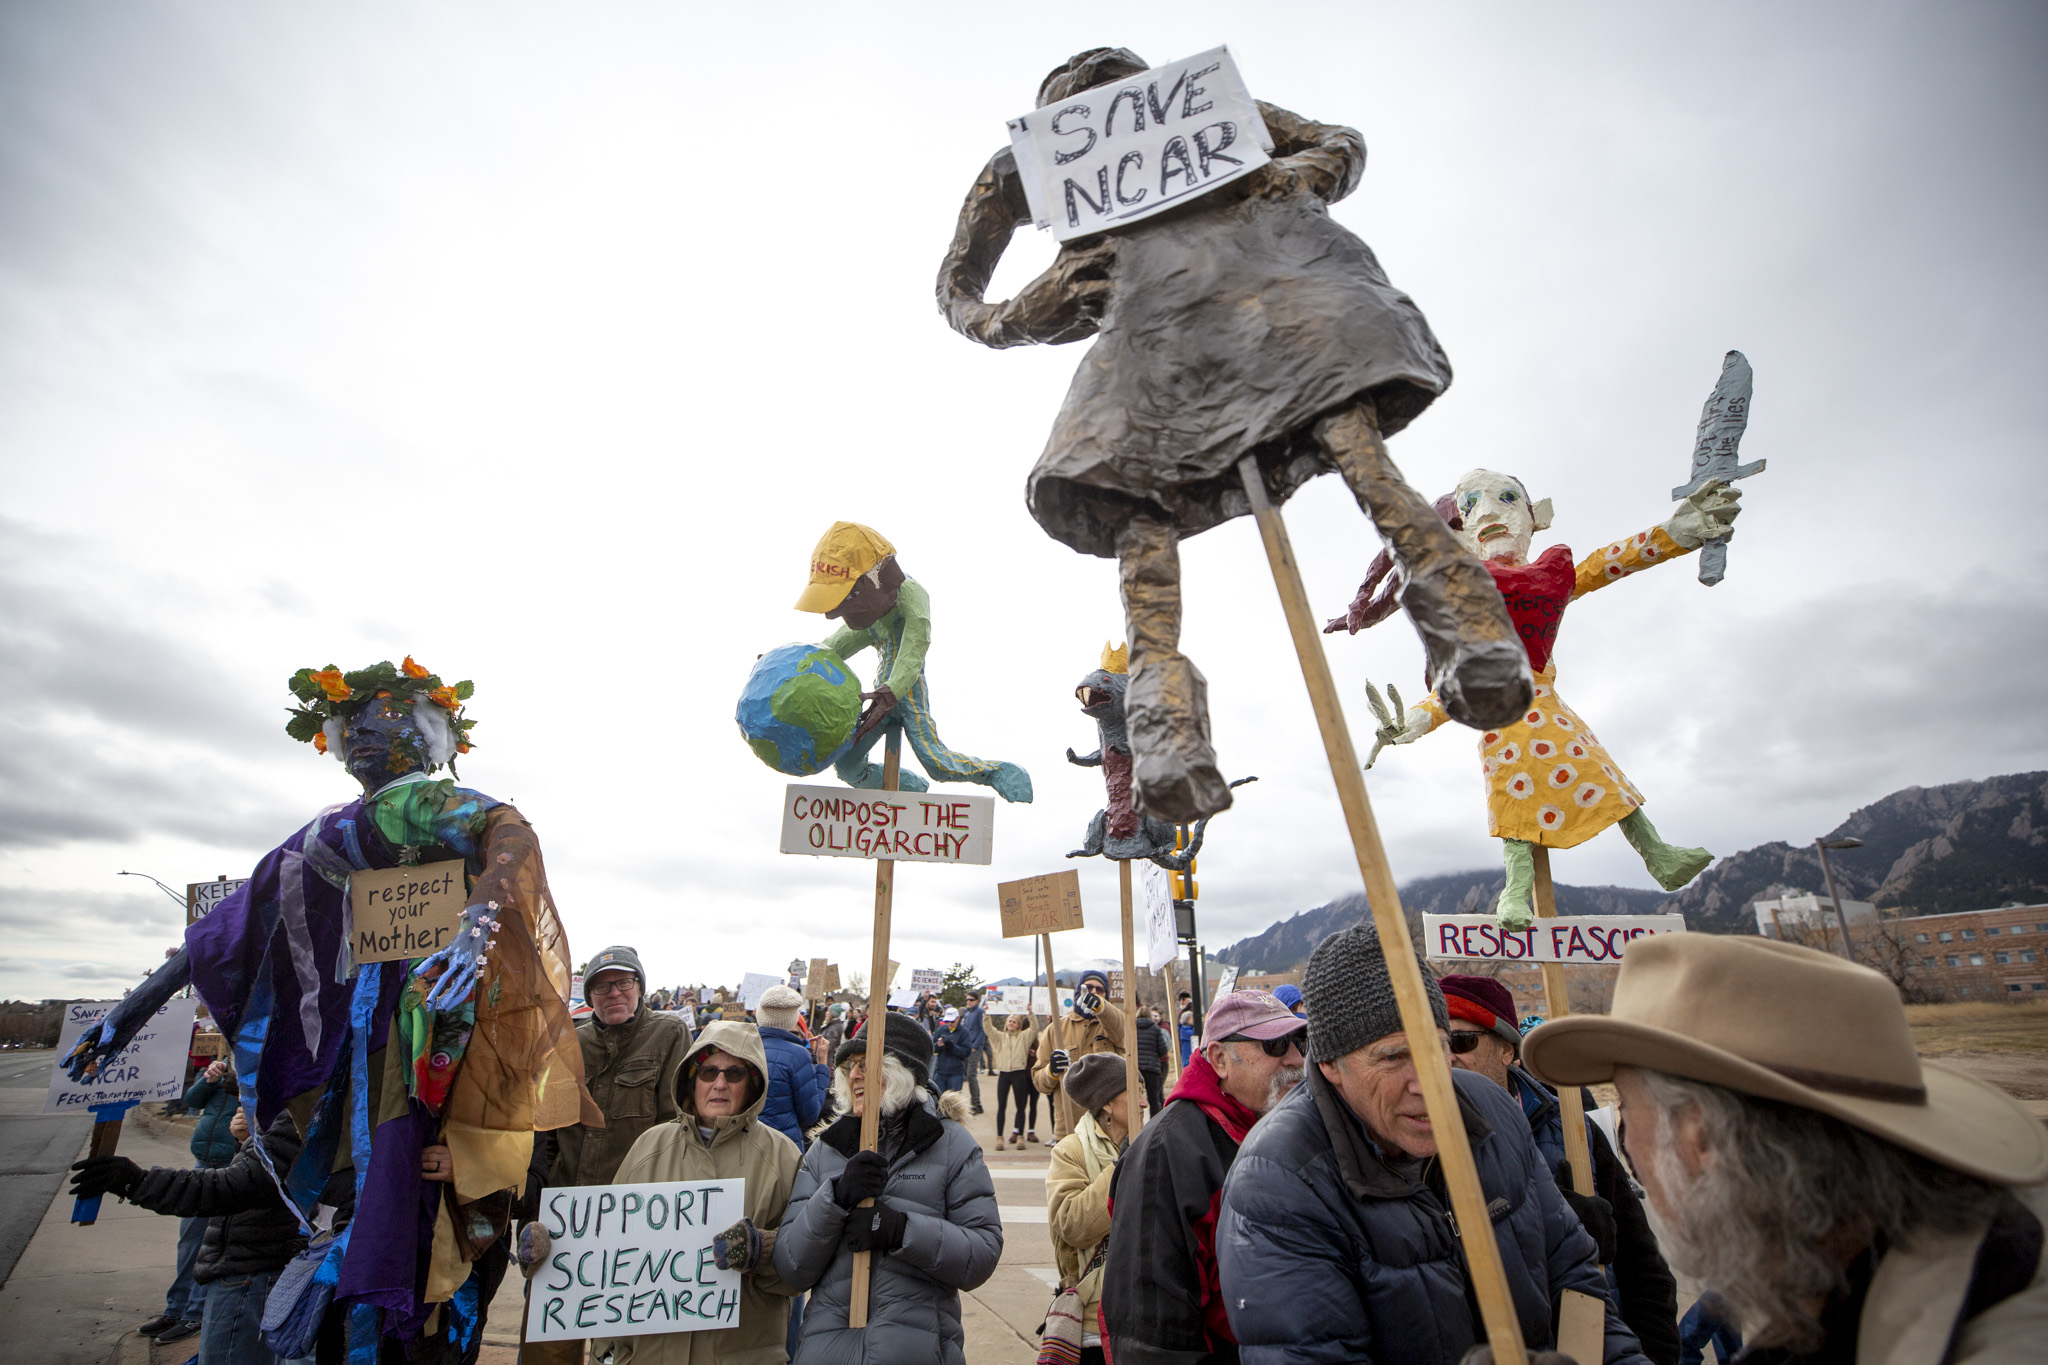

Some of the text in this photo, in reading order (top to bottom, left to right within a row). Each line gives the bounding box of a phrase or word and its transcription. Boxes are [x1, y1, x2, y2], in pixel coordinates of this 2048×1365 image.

[1051, 62, 1220, 165] SAVE
[1064, 121, 1244, 228] NCAR
[1713, 397, 1746, 458] the lies
[1521, 621, 1558, 640] ove
[794, 795, 970, 831] COMPOST THE
[809, 823, 969, 860] OLIGARCHY
[369, 872, 454, 905] respect
[389, 901, 430, 926] your
[360, 924, 449, 954] Mother
[1439, 923, 1539, 958] RESIST
[912, 976, 939, 984] SCIENCE
[898, 1173, 926, 1181] Marmot
[547, 1187, 724, 1239] SUPPORT
[546, 1245, 718, 1292] SCIENCE
[541, 1288, 738, 1334] RESEARCH
